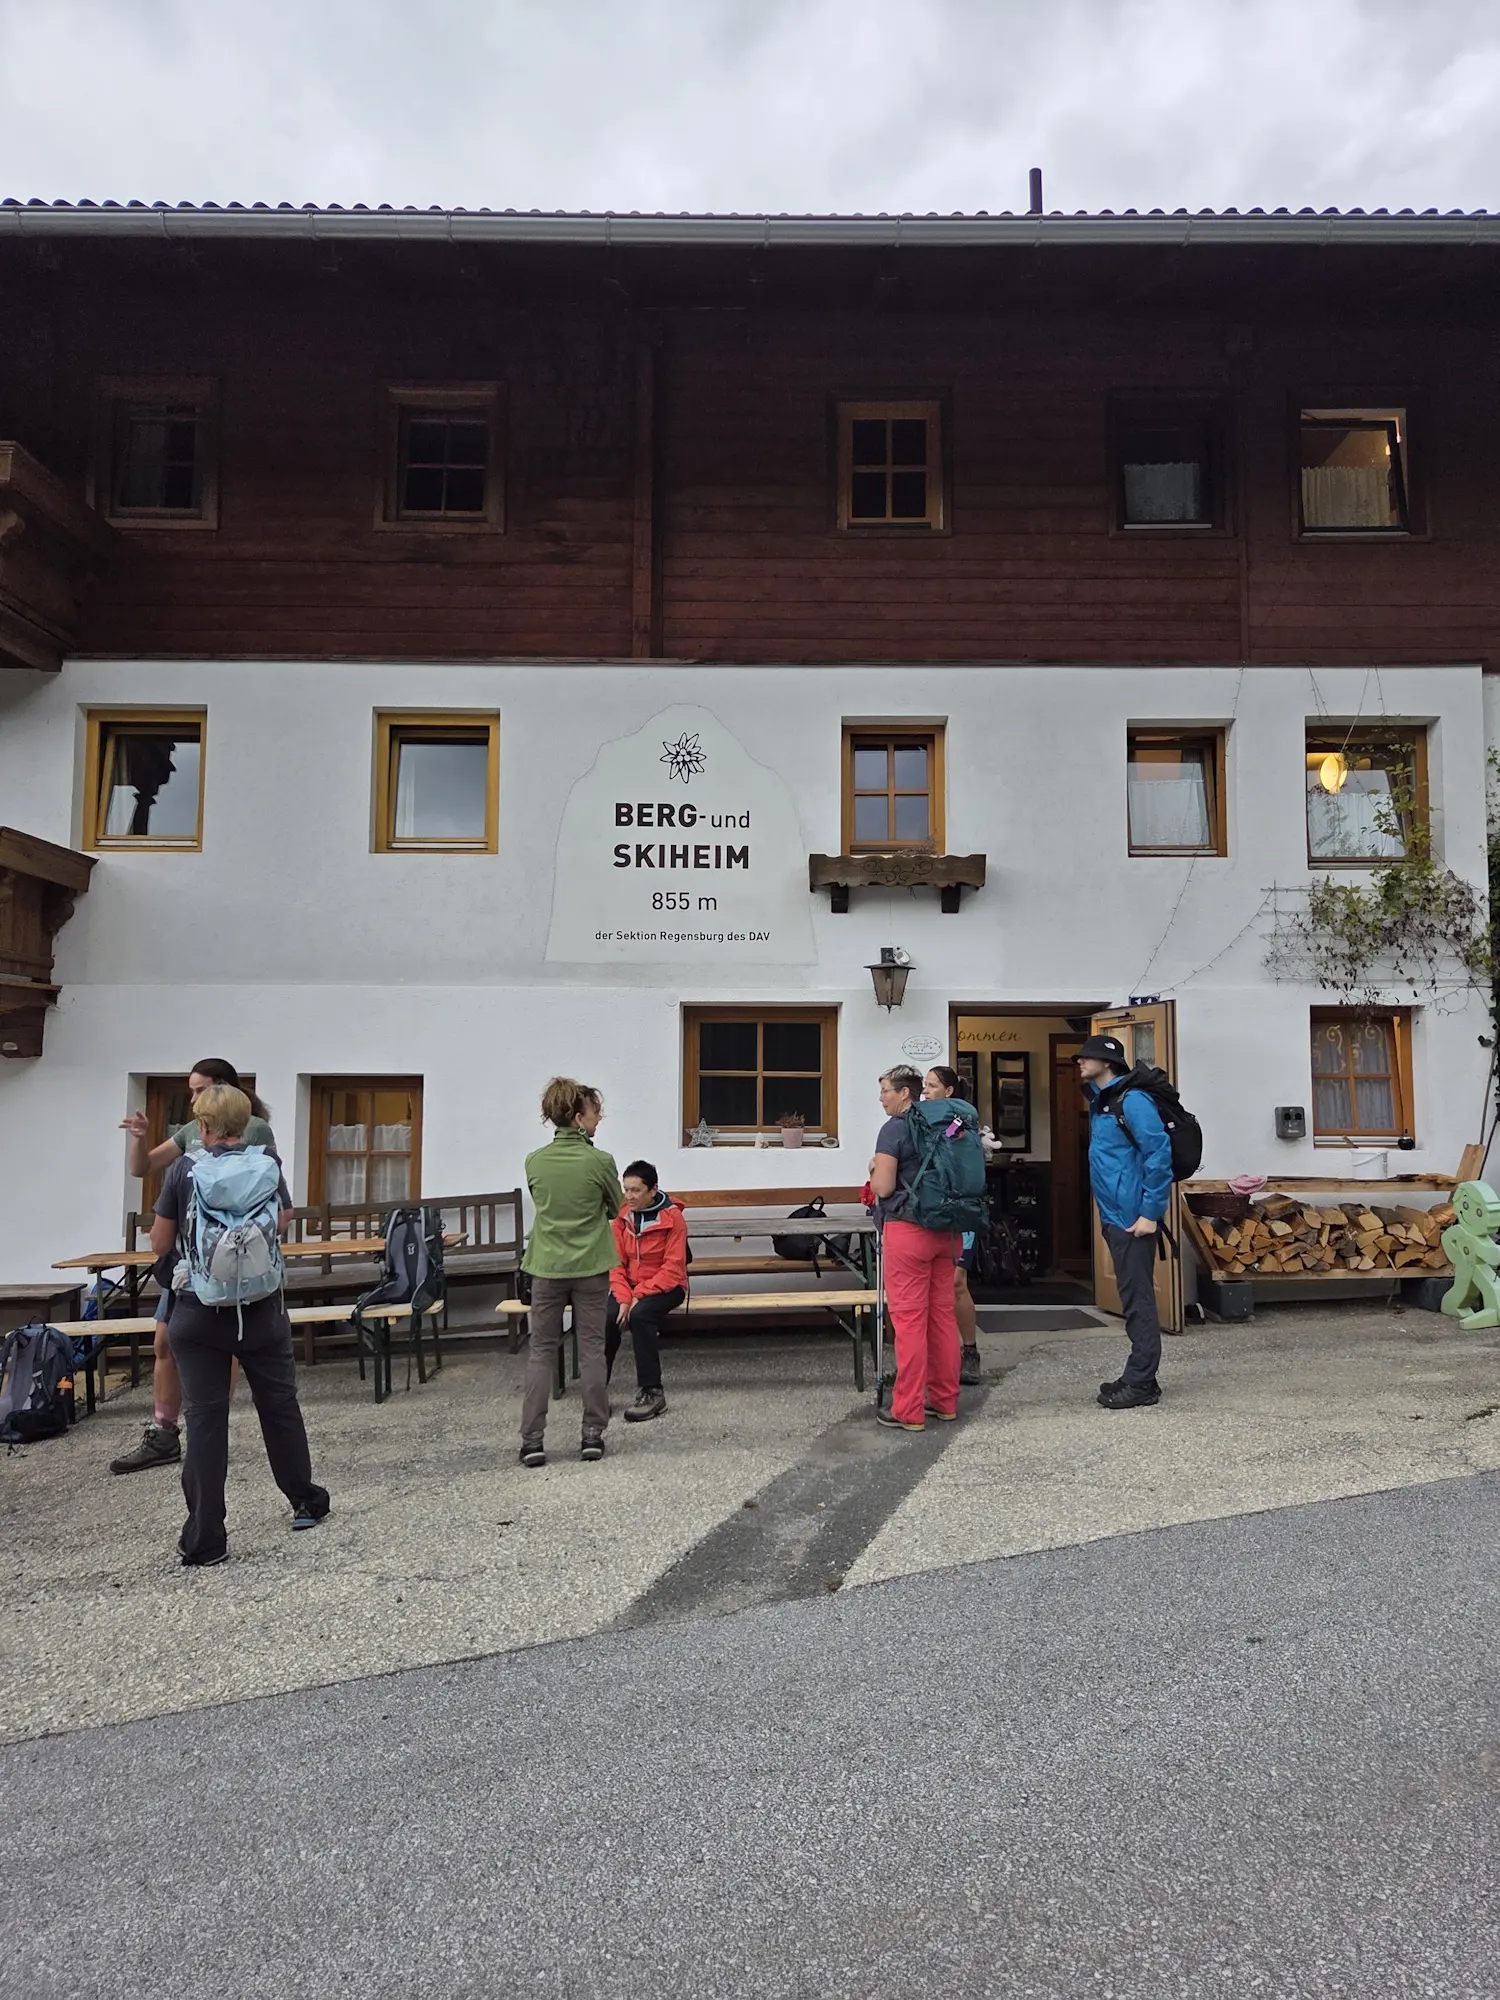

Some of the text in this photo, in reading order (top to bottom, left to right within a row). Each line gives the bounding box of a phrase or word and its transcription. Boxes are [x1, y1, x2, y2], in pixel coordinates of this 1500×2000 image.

[711, 810, 750, 829] und
[612, 843, 750, 870] SKIHEIM
[652, 891, 718, 911] 855 m
[595, 930, 771, 944] der Sektion Regensburg des DAV
